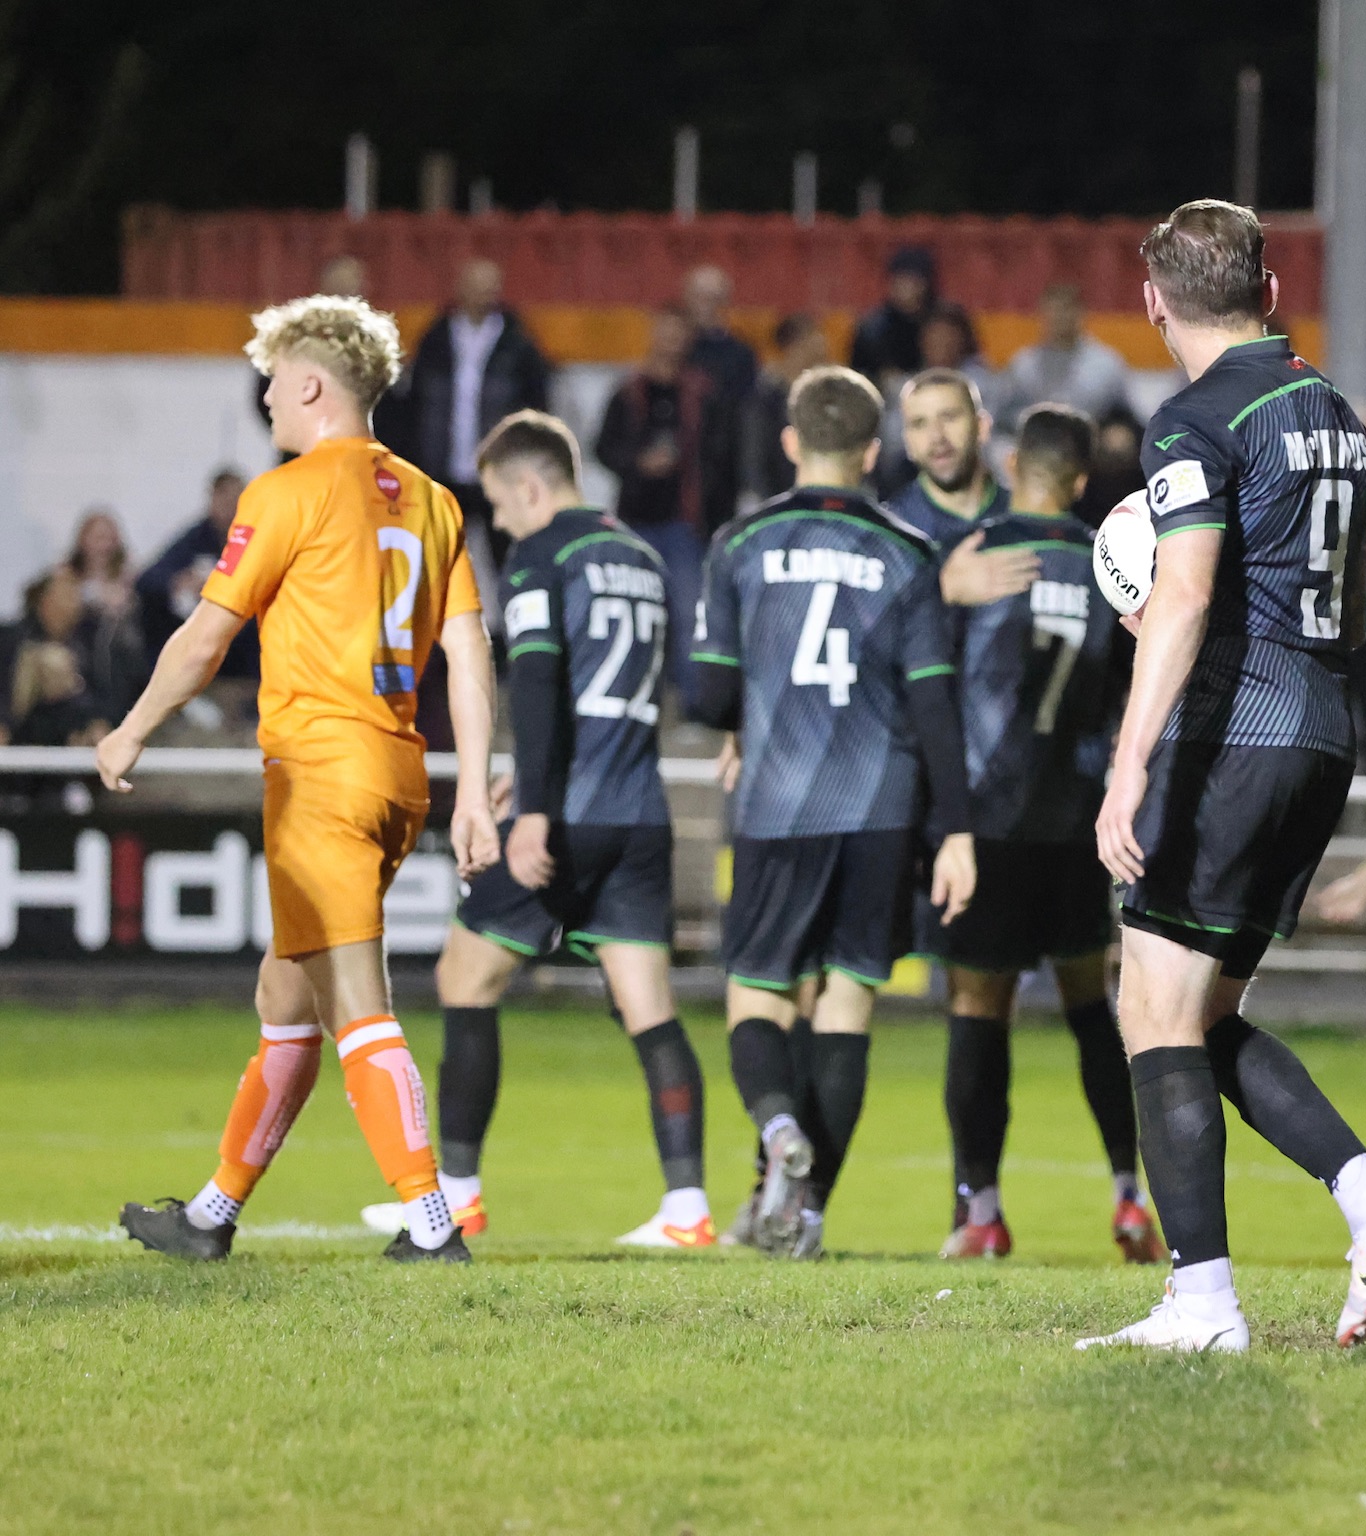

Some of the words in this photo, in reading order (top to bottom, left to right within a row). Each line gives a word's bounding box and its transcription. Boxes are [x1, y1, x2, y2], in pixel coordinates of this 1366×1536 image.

[377, 526, 422, 650] 2
[1300, 478, 1353, 639] 9
[576, 597, 669, 726] 22
[790, 582, 858, 707] 4
[1032, 614, 1087, 734] 7
